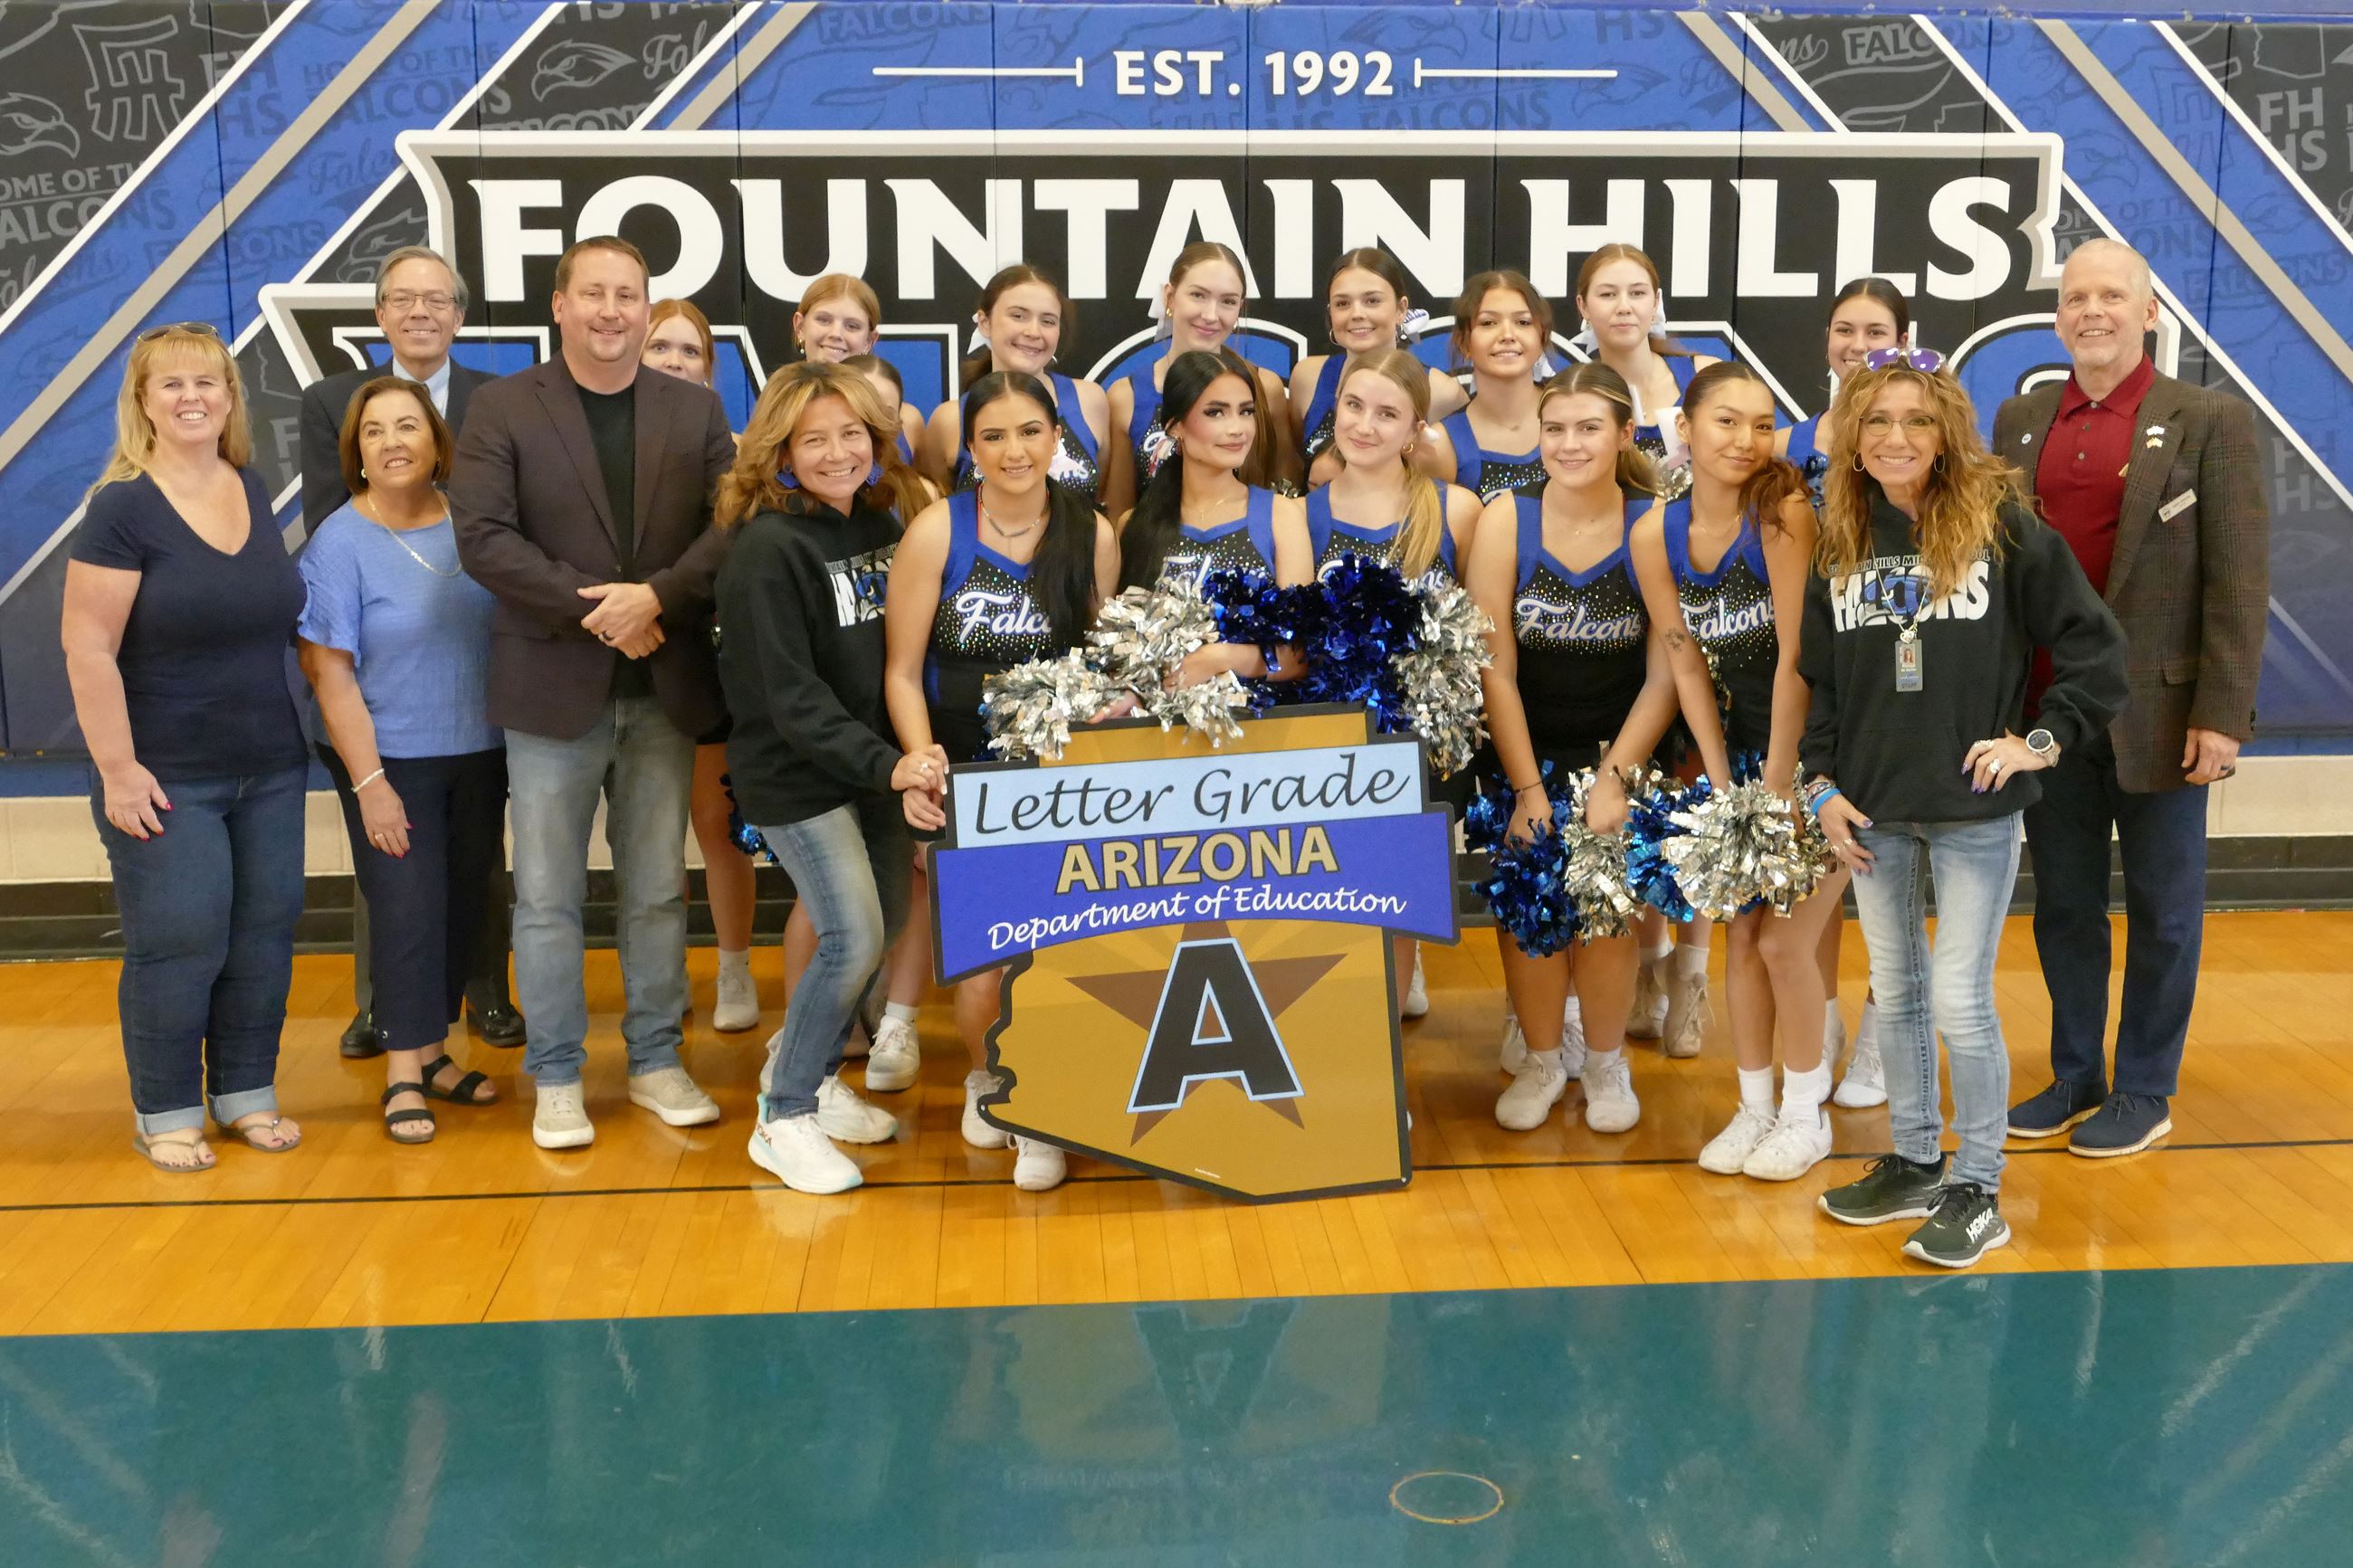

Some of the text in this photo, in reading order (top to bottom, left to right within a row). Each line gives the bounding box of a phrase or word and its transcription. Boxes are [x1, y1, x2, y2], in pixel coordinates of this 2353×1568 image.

[1113, 50, 1240, 95] EST.
[1265, 51, 1394, 95] 1992
[2256, 87, 2324, 134] FH
[62, 166, 101, 194] OF
[468, 176, 2011, 302] FOUNTAIN HILLS
[1516, 597, 1642, 640] Falcons
[975, 753, 1411, 834] Letter Grade
[1054, 824, 1339, 895] ARIZONA
[987, 883, 1408, 951] Department of Education
[1126, 937, 1305, 1113] A
